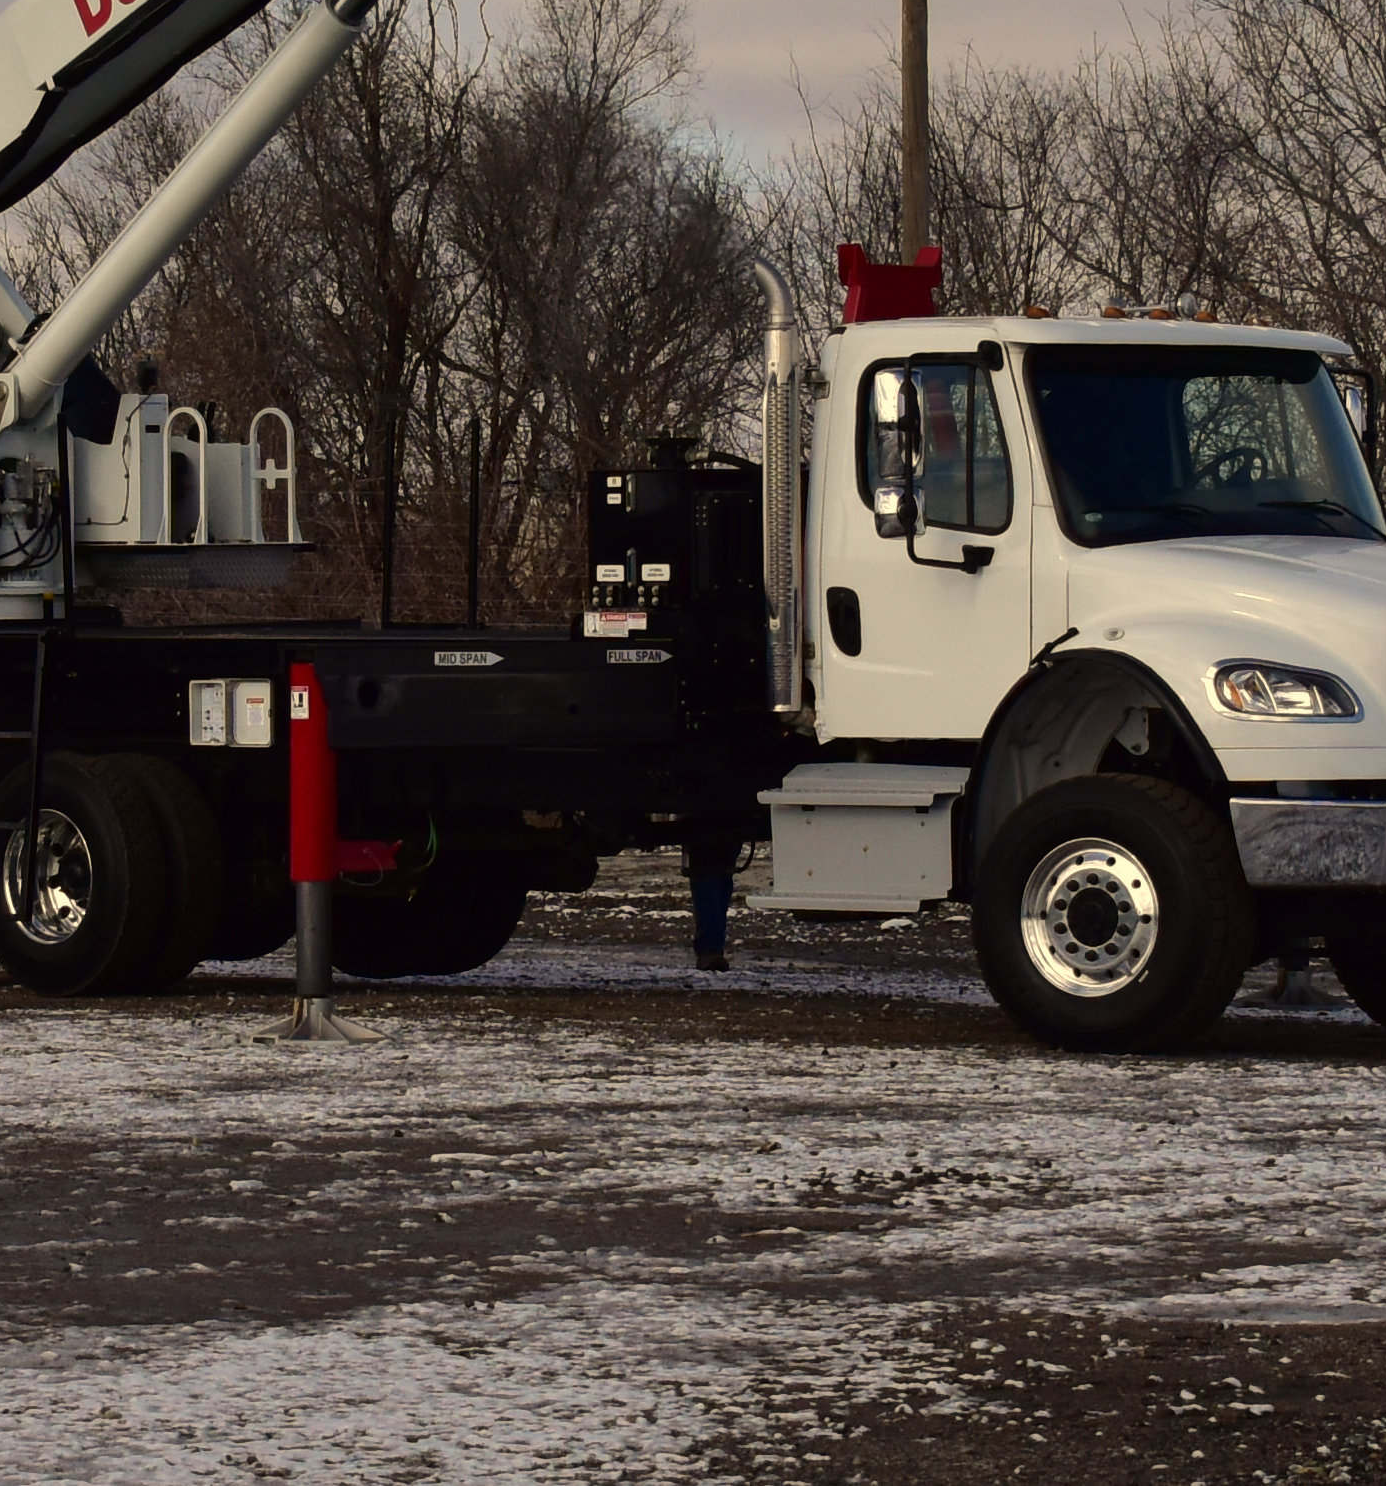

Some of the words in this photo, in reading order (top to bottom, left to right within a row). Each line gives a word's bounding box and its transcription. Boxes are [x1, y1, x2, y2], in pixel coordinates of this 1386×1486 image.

[438, 653, 457, 664] MID
[459, 653, 488, 664] SPAN
[608, 651, 633, 662] FULL
[635, 650, 662, 662] SPAN
